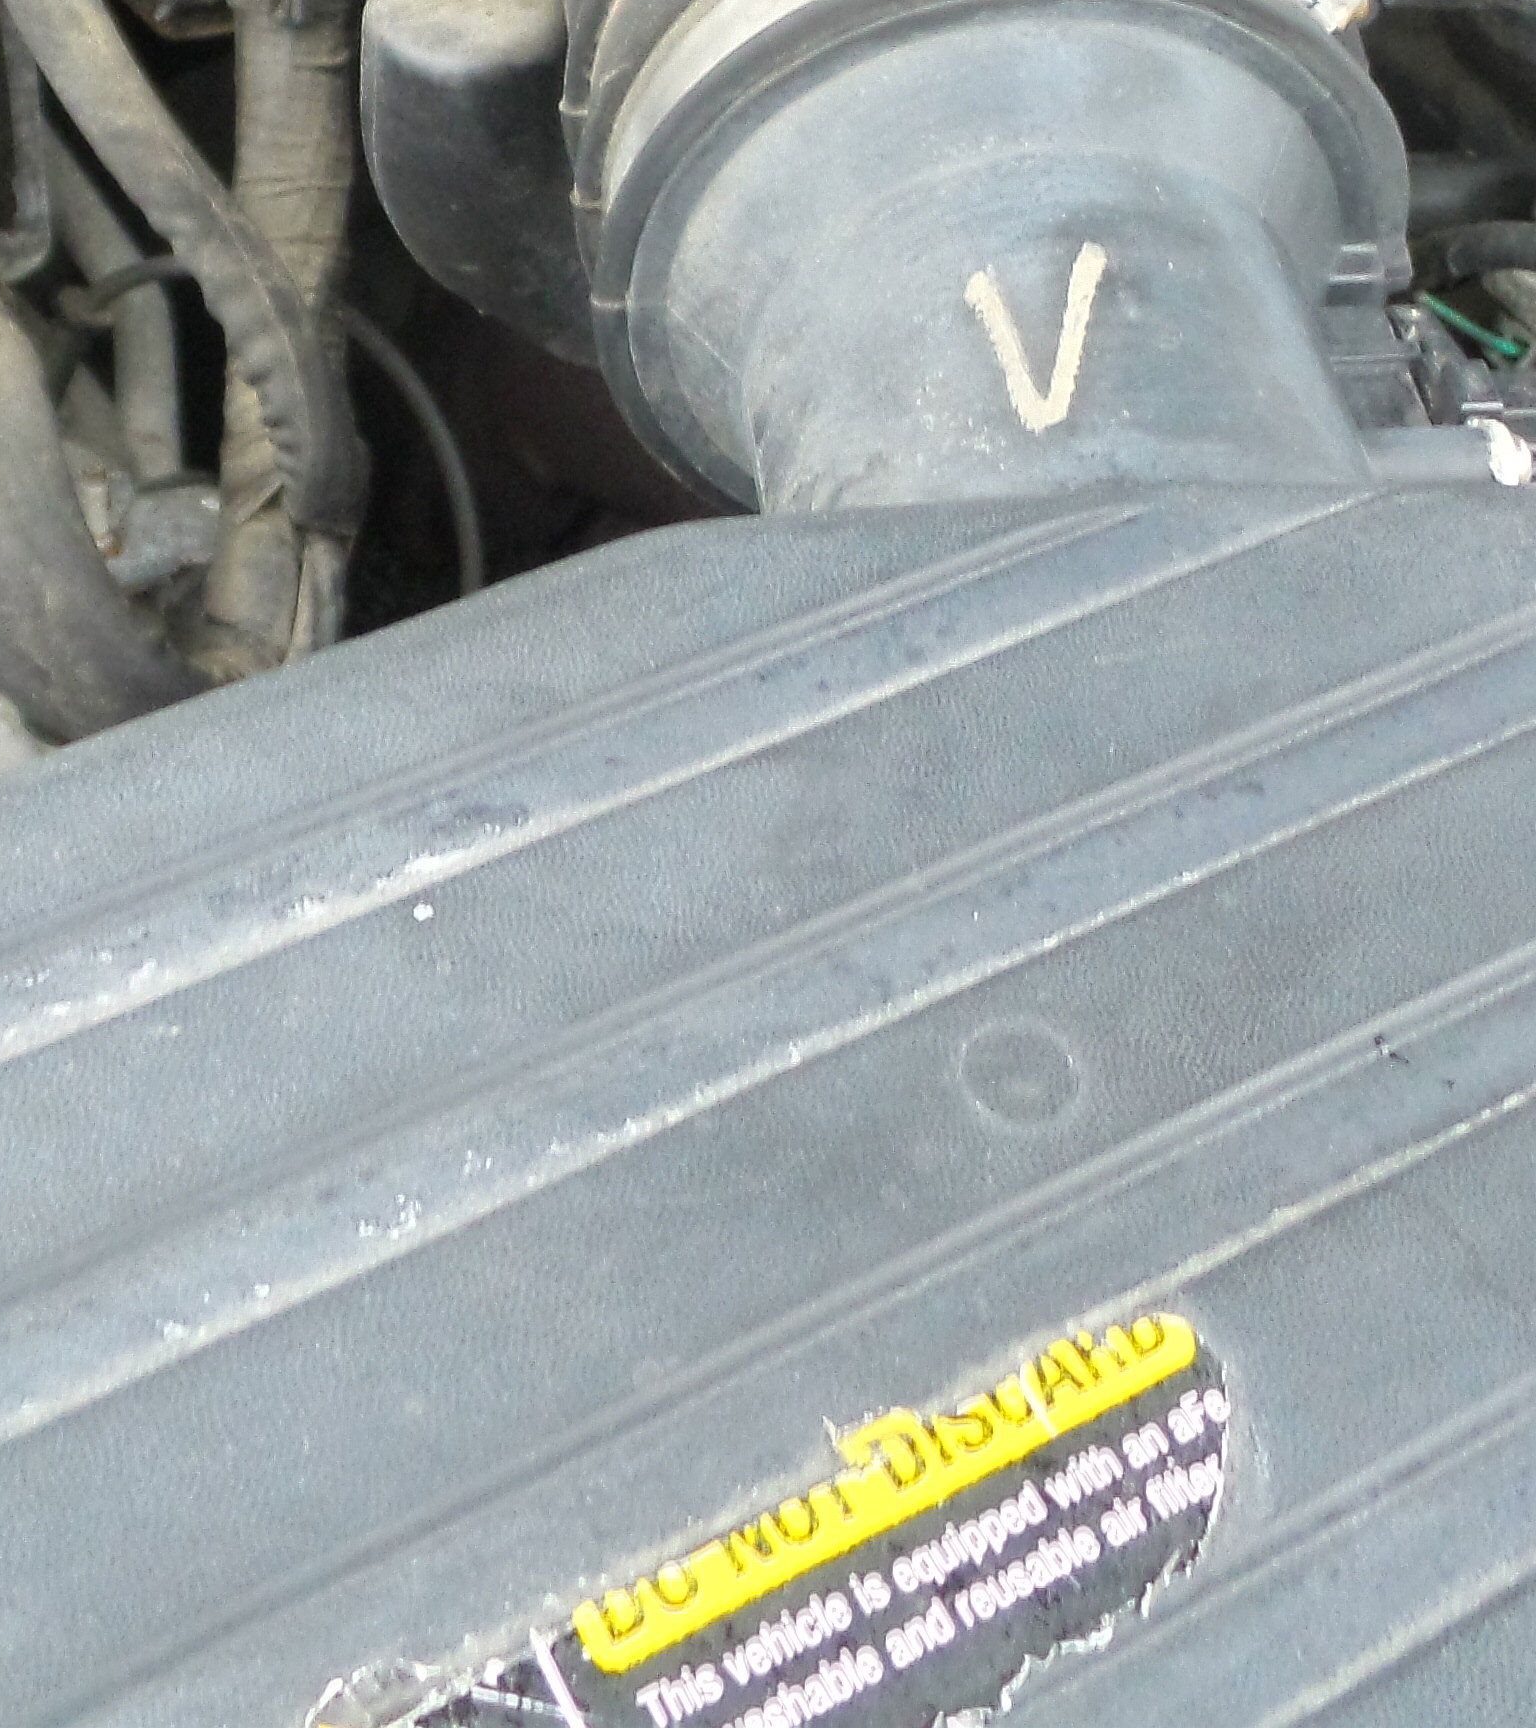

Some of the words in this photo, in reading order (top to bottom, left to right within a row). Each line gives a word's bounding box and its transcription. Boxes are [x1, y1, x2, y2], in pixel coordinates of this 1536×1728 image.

[963, 240, 1108, 435] V
[635, 1663, 724, 1728] This
[722, 1591, 853, 1685] vehicle
[849, 1571, 892, 1616] is
[892, 1478, 1048, 1593] equipped
[1044, 1444, 1124, 1509] with
[1122, 1422, 1169, 1469] an
[1167, 1389, 1231, 1444] aFe
[721, 1644, 884, 1728] ashable
[885, 1595, 956, 1664] and
[954, 1525, 1101, 1628] reusable
[1100, 1496, 1148, 1547] air
[1145, 1452, 1221, 1519] filter
